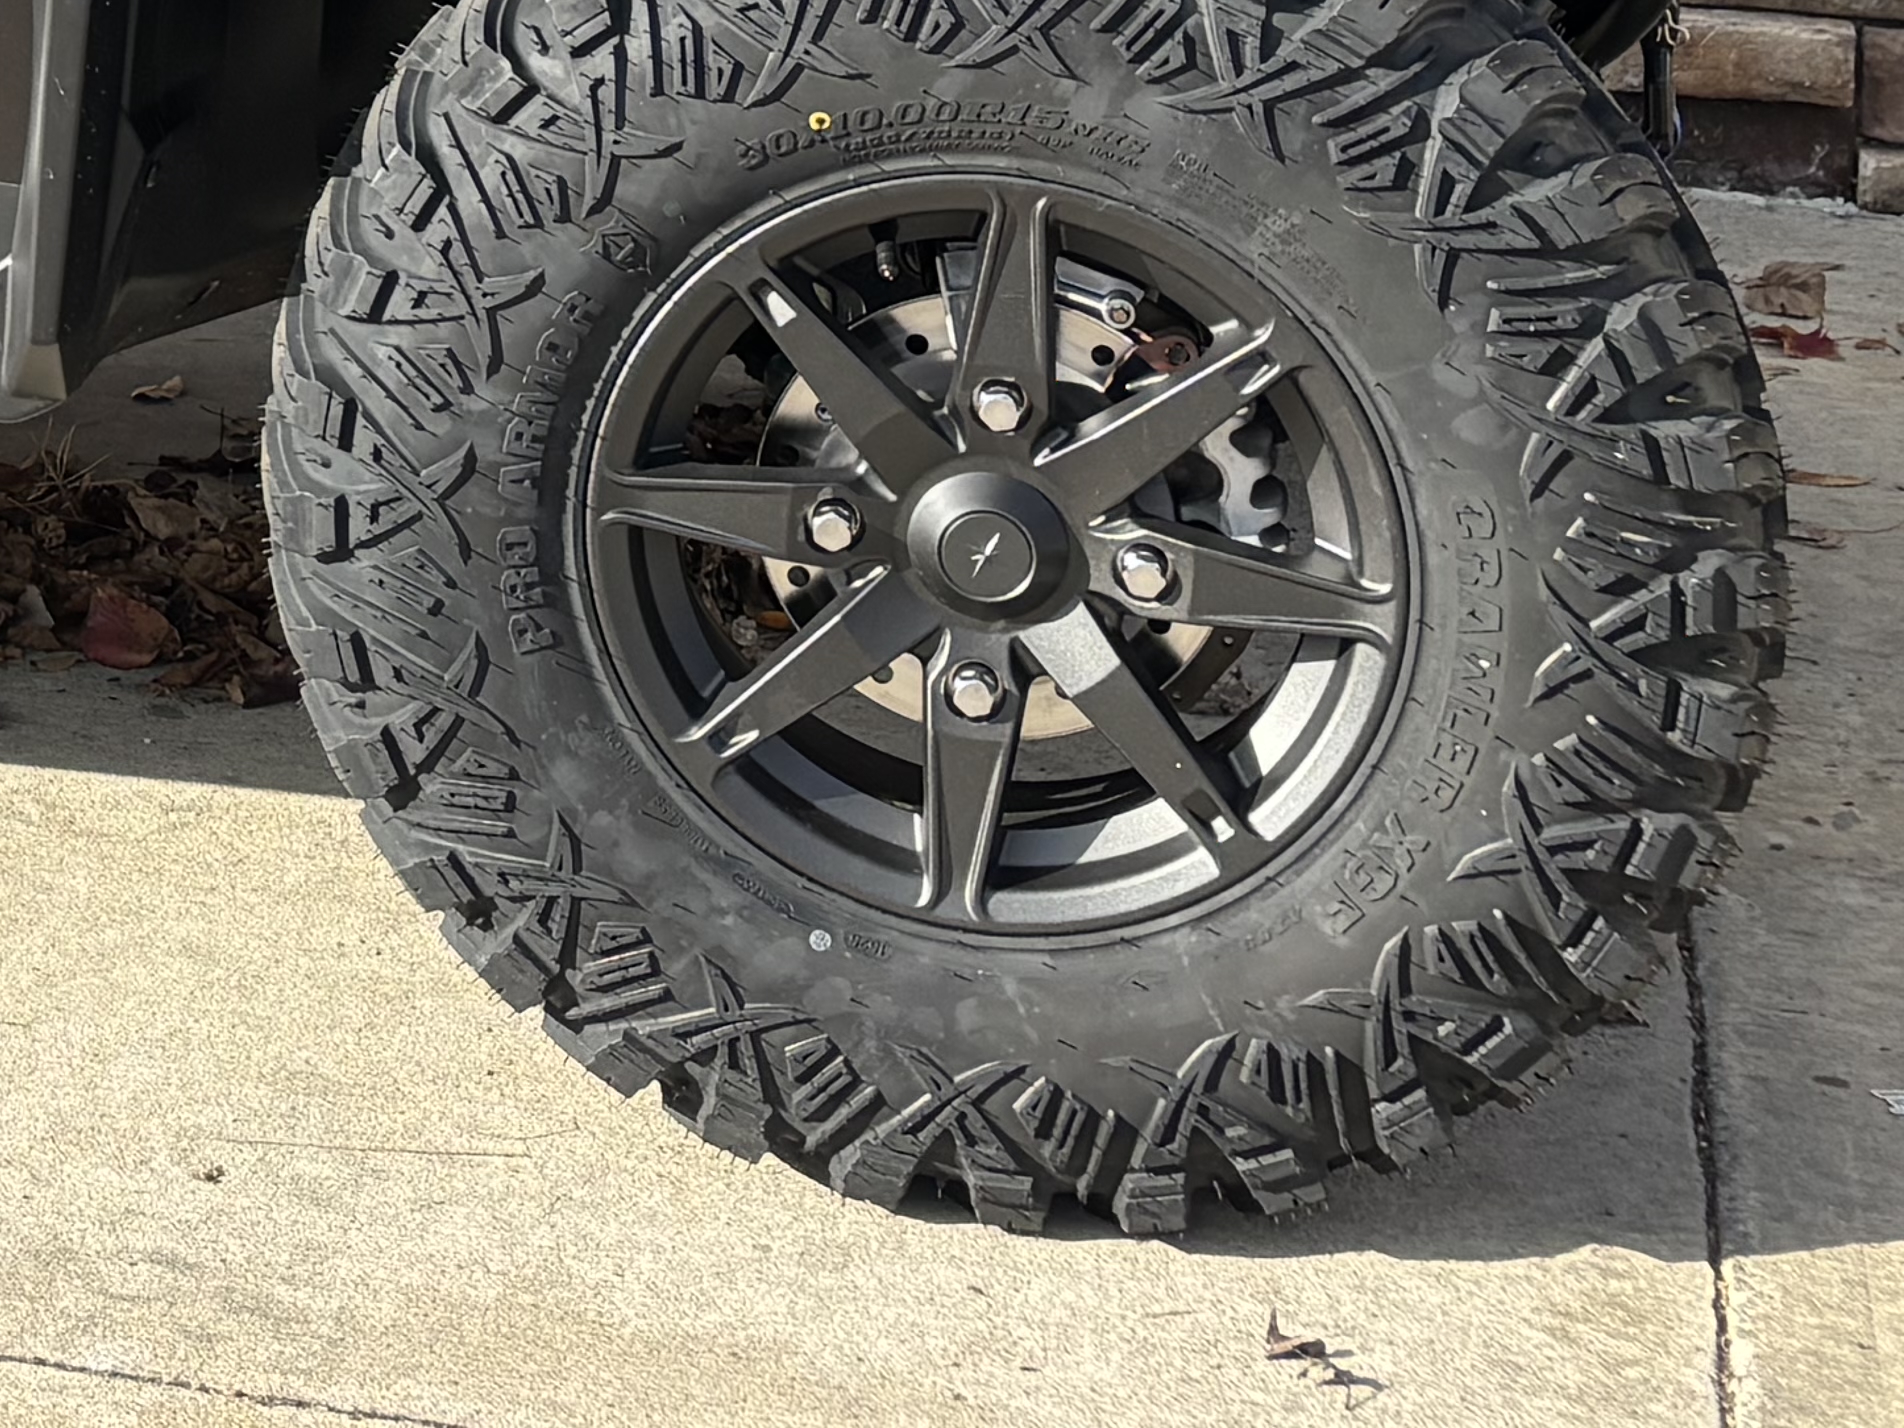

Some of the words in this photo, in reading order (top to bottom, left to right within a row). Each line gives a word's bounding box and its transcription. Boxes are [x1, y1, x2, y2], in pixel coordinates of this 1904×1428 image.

[496, 289, 607, 505] ARMOR
[496, 524, 555, 657] PRO
[1413, 495, 1504, 815] CRAWLER
